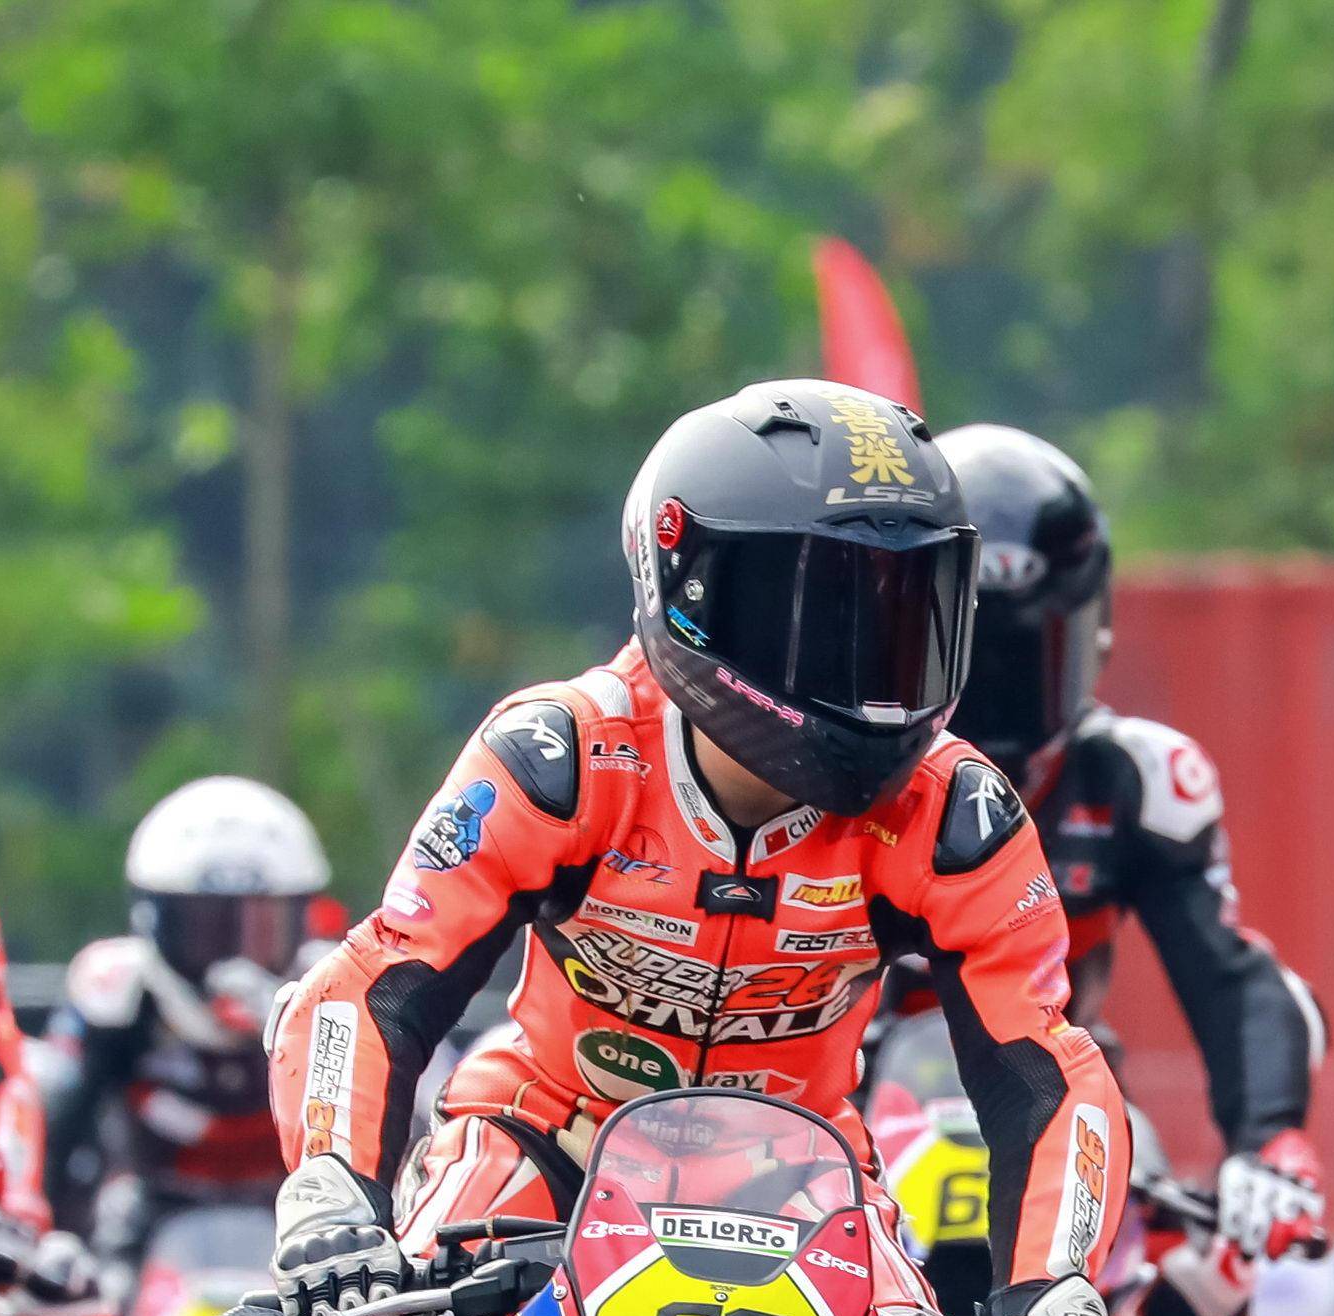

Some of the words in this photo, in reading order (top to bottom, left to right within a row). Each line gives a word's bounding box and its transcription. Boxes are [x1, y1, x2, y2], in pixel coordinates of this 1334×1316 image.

[826, 486, 935, 507] LS2
[598, 1044, 662, 1077] one
[662, 1217, 786, 1249] DELLORTO
